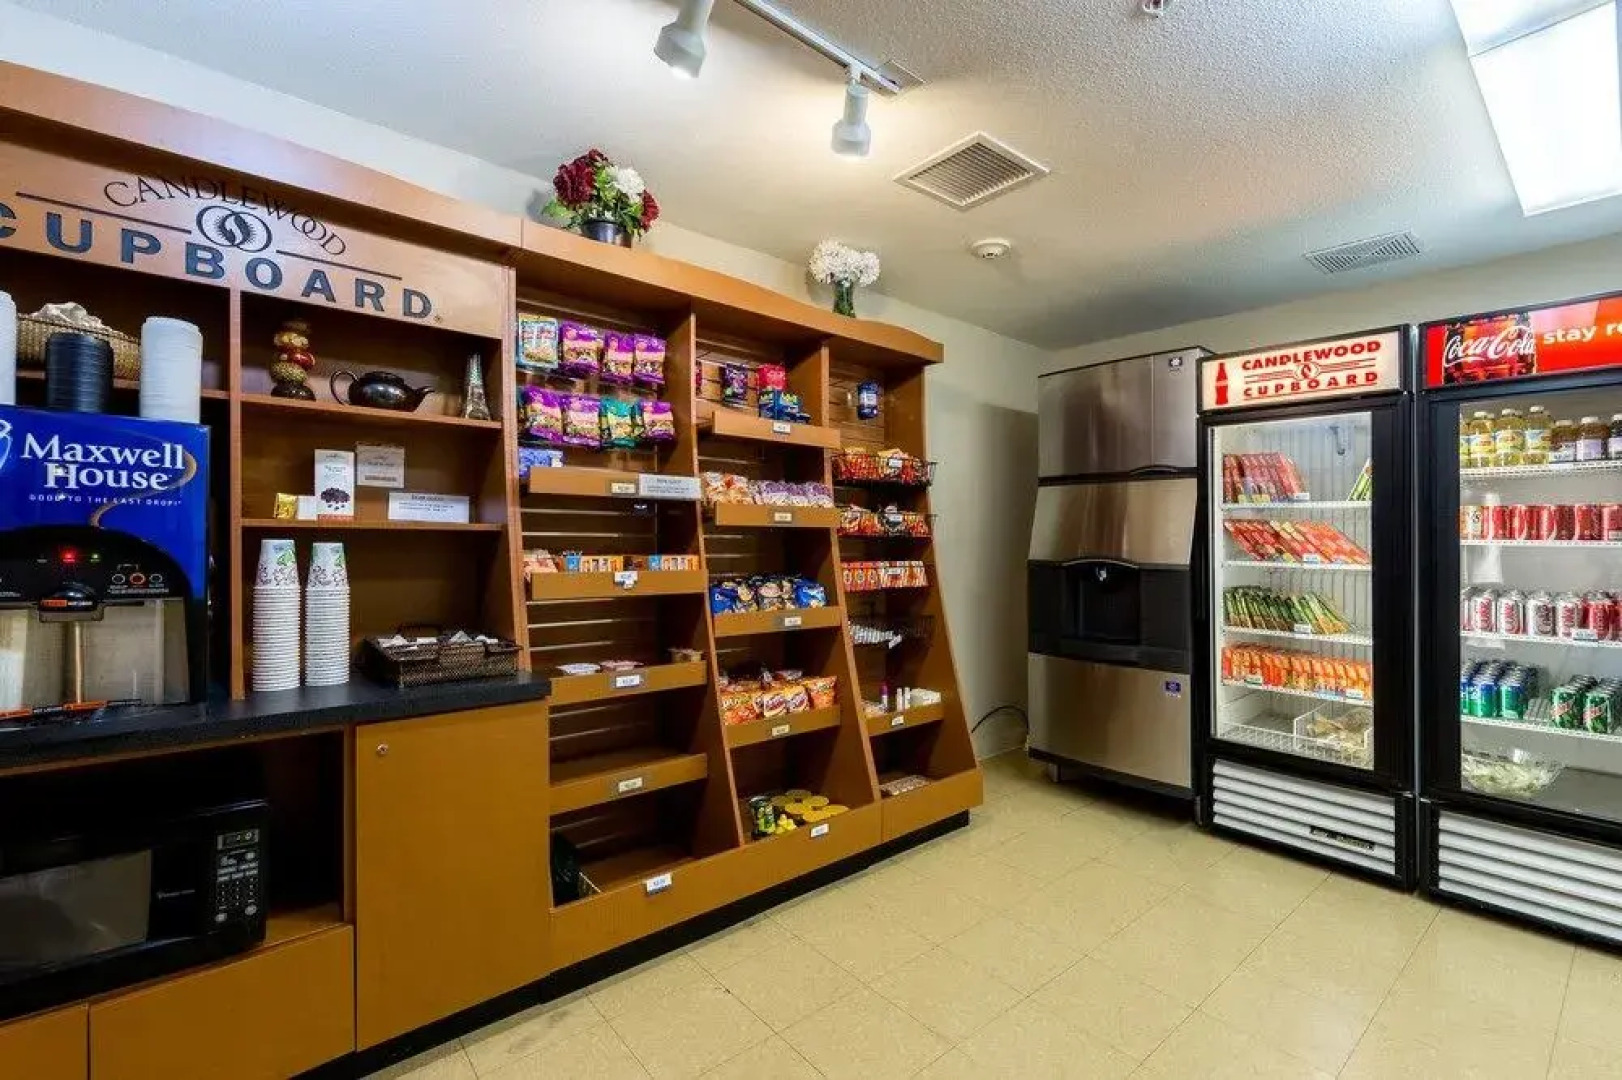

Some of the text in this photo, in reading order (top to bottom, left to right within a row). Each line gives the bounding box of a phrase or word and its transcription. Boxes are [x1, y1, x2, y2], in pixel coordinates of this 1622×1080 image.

[104, 176, 346, 256] CANDLEWOOD
[1442, 325, 1535, 367] Coca-Cola
[1543, 325, 1597, 345] stay
[1241, 340, 1382, 371] CANDLEWOOD
[1243, 371, 1378, 397] CUPBOARD
[20, 432, 186, 470] Maxwell
[44, 461, 168, 490] House
[68, 495, 82, 503] TO
[87, 496, 108, 504] THE
